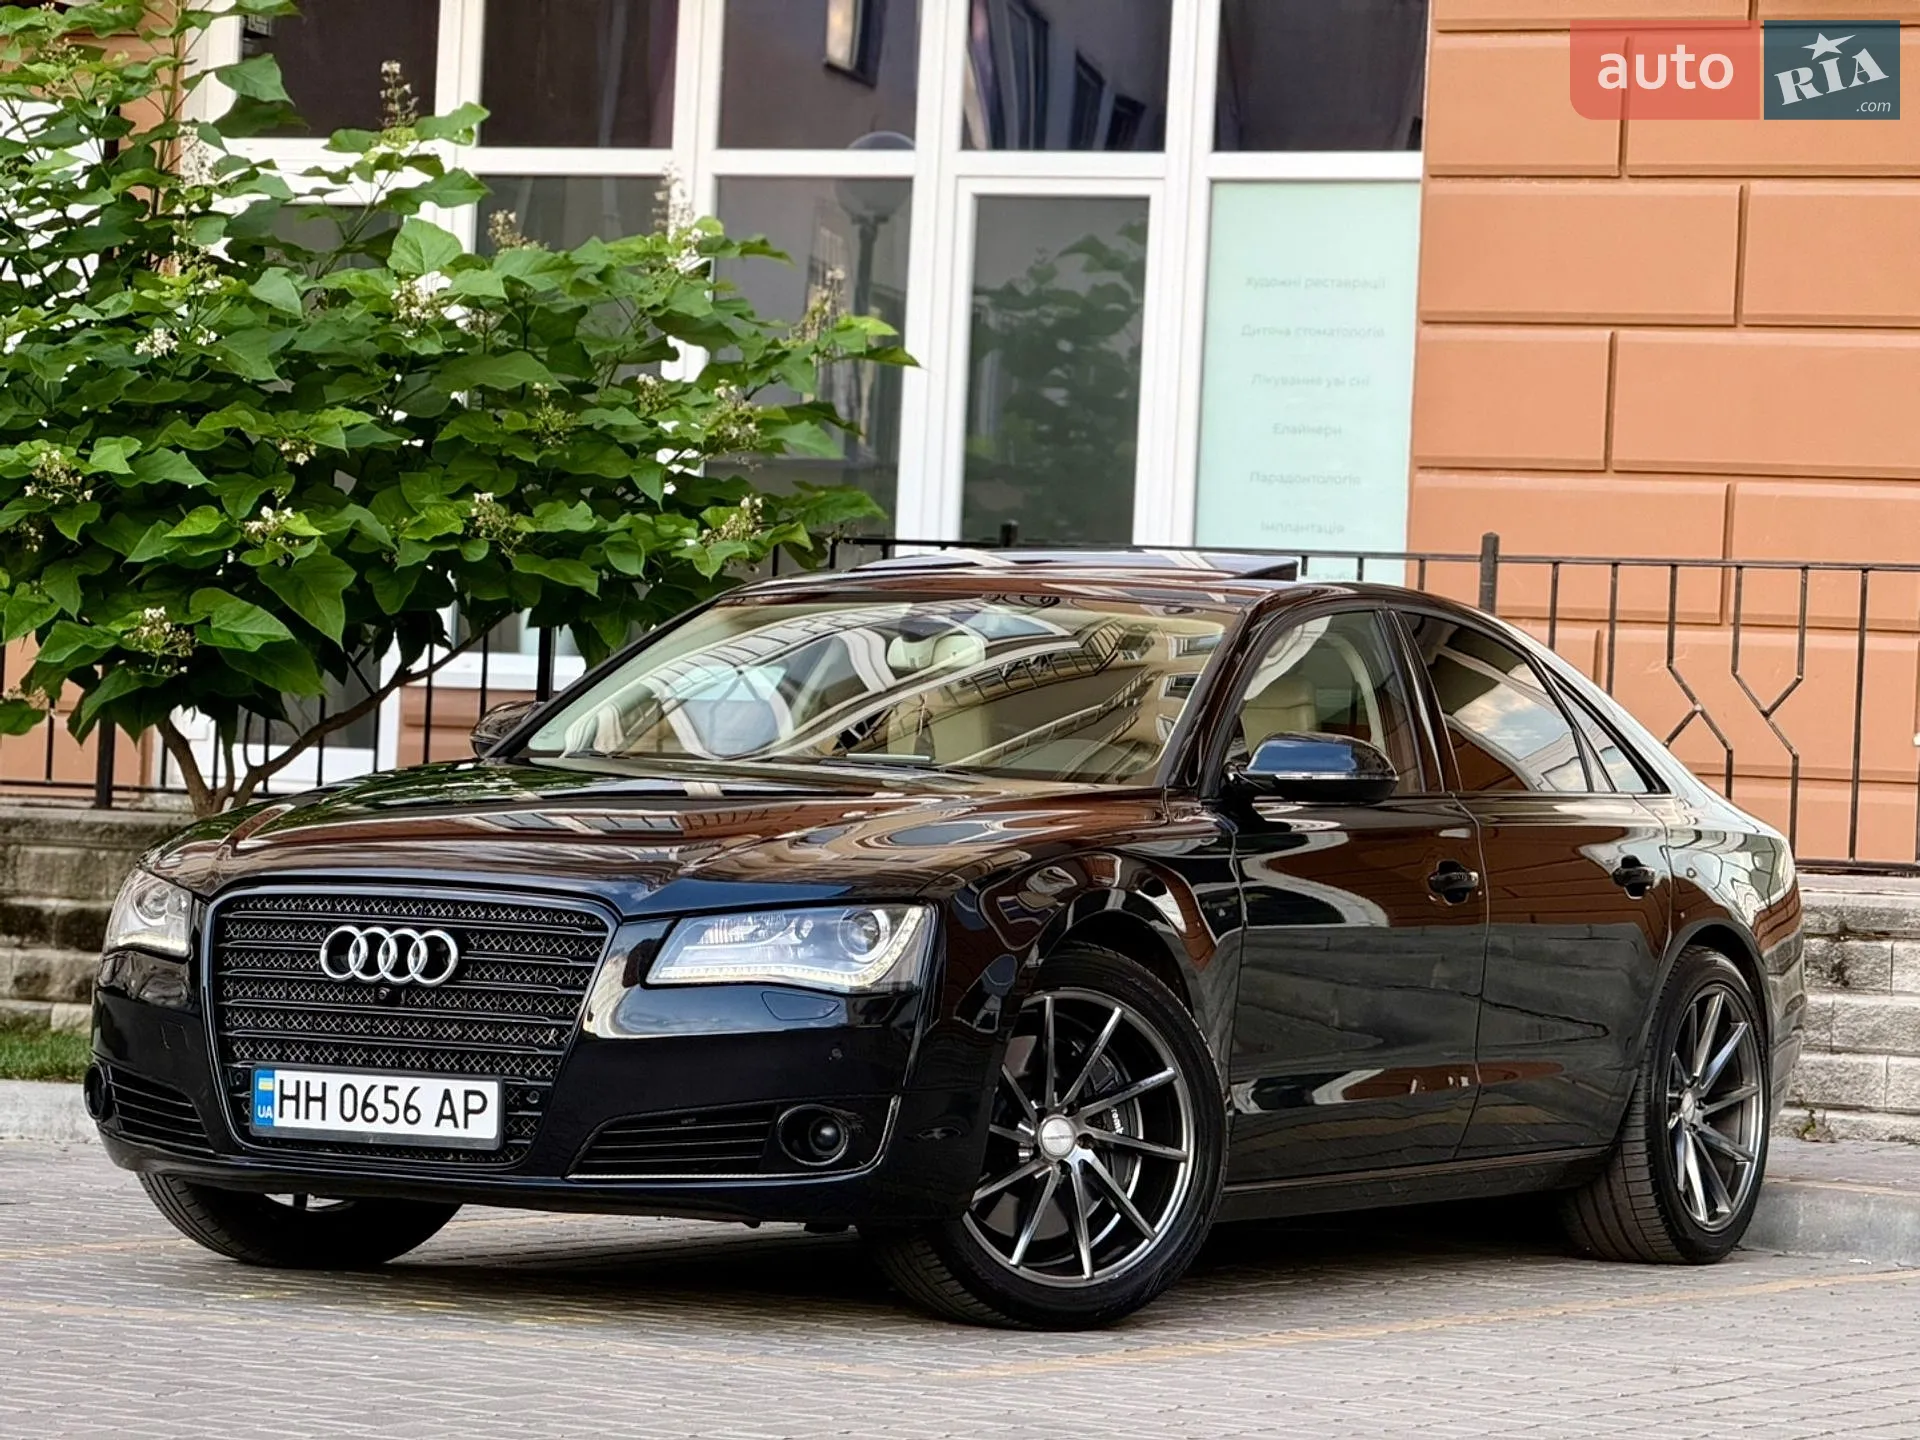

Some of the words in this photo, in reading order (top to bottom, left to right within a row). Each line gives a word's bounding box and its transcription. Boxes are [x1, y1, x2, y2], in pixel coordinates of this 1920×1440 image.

[1294, 326, 1386, 338] стоматологія
[1272, 422, 1343, 439] Елайнери
[257, 1104, 273, 1119] UA
[278, 1078, 327, 1121] HH
[339, 1082, 422, 1126] 0656
[434, 1087, 489, 1130] AP
